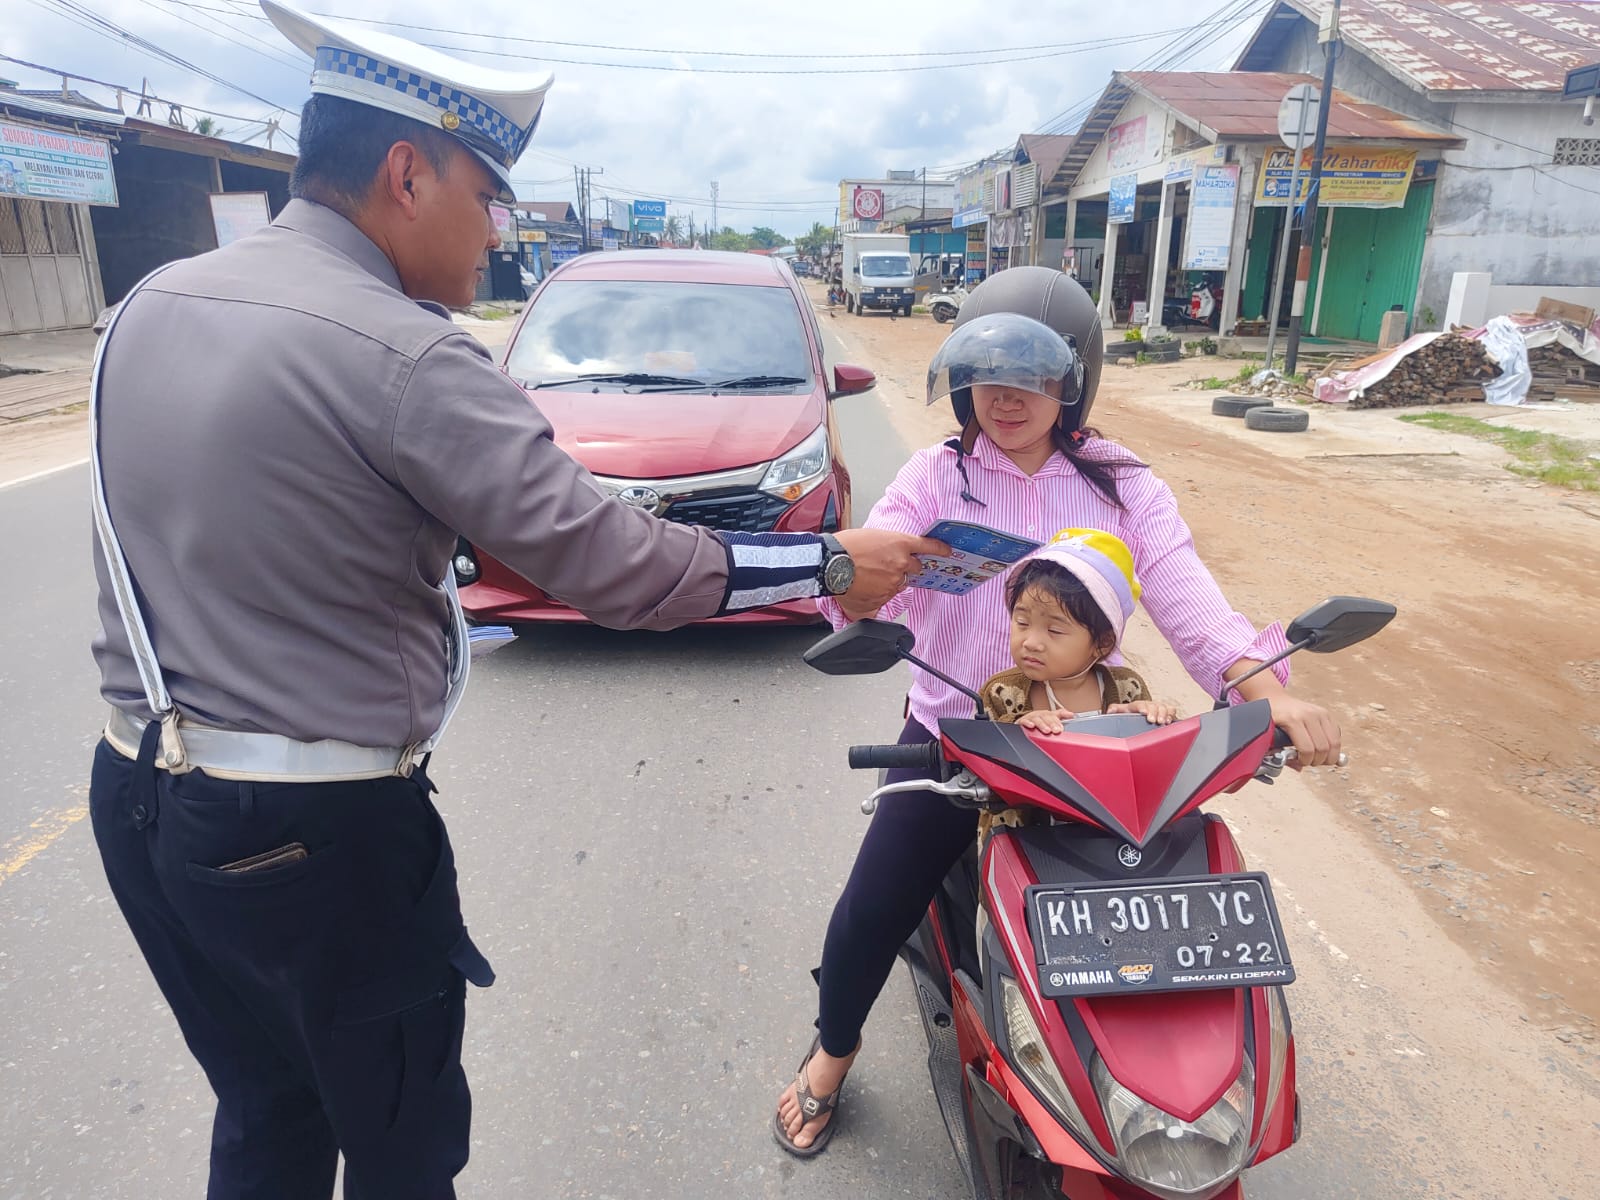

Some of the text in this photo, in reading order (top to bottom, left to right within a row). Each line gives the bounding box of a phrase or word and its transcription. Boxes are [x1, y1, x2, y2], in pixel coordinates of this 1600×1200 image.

[1195, 179, 1236, 189] MAHARDIKA
[637, 202, 663, 213] vivo
[1047, 890, 1255, 936] KH 3017 YC
[1062, 969, 1114, 986] YAMAHA
[1125, 973, 1147, 981] YAMAHA
[1244, 969, 1286, 979] DEPAN
